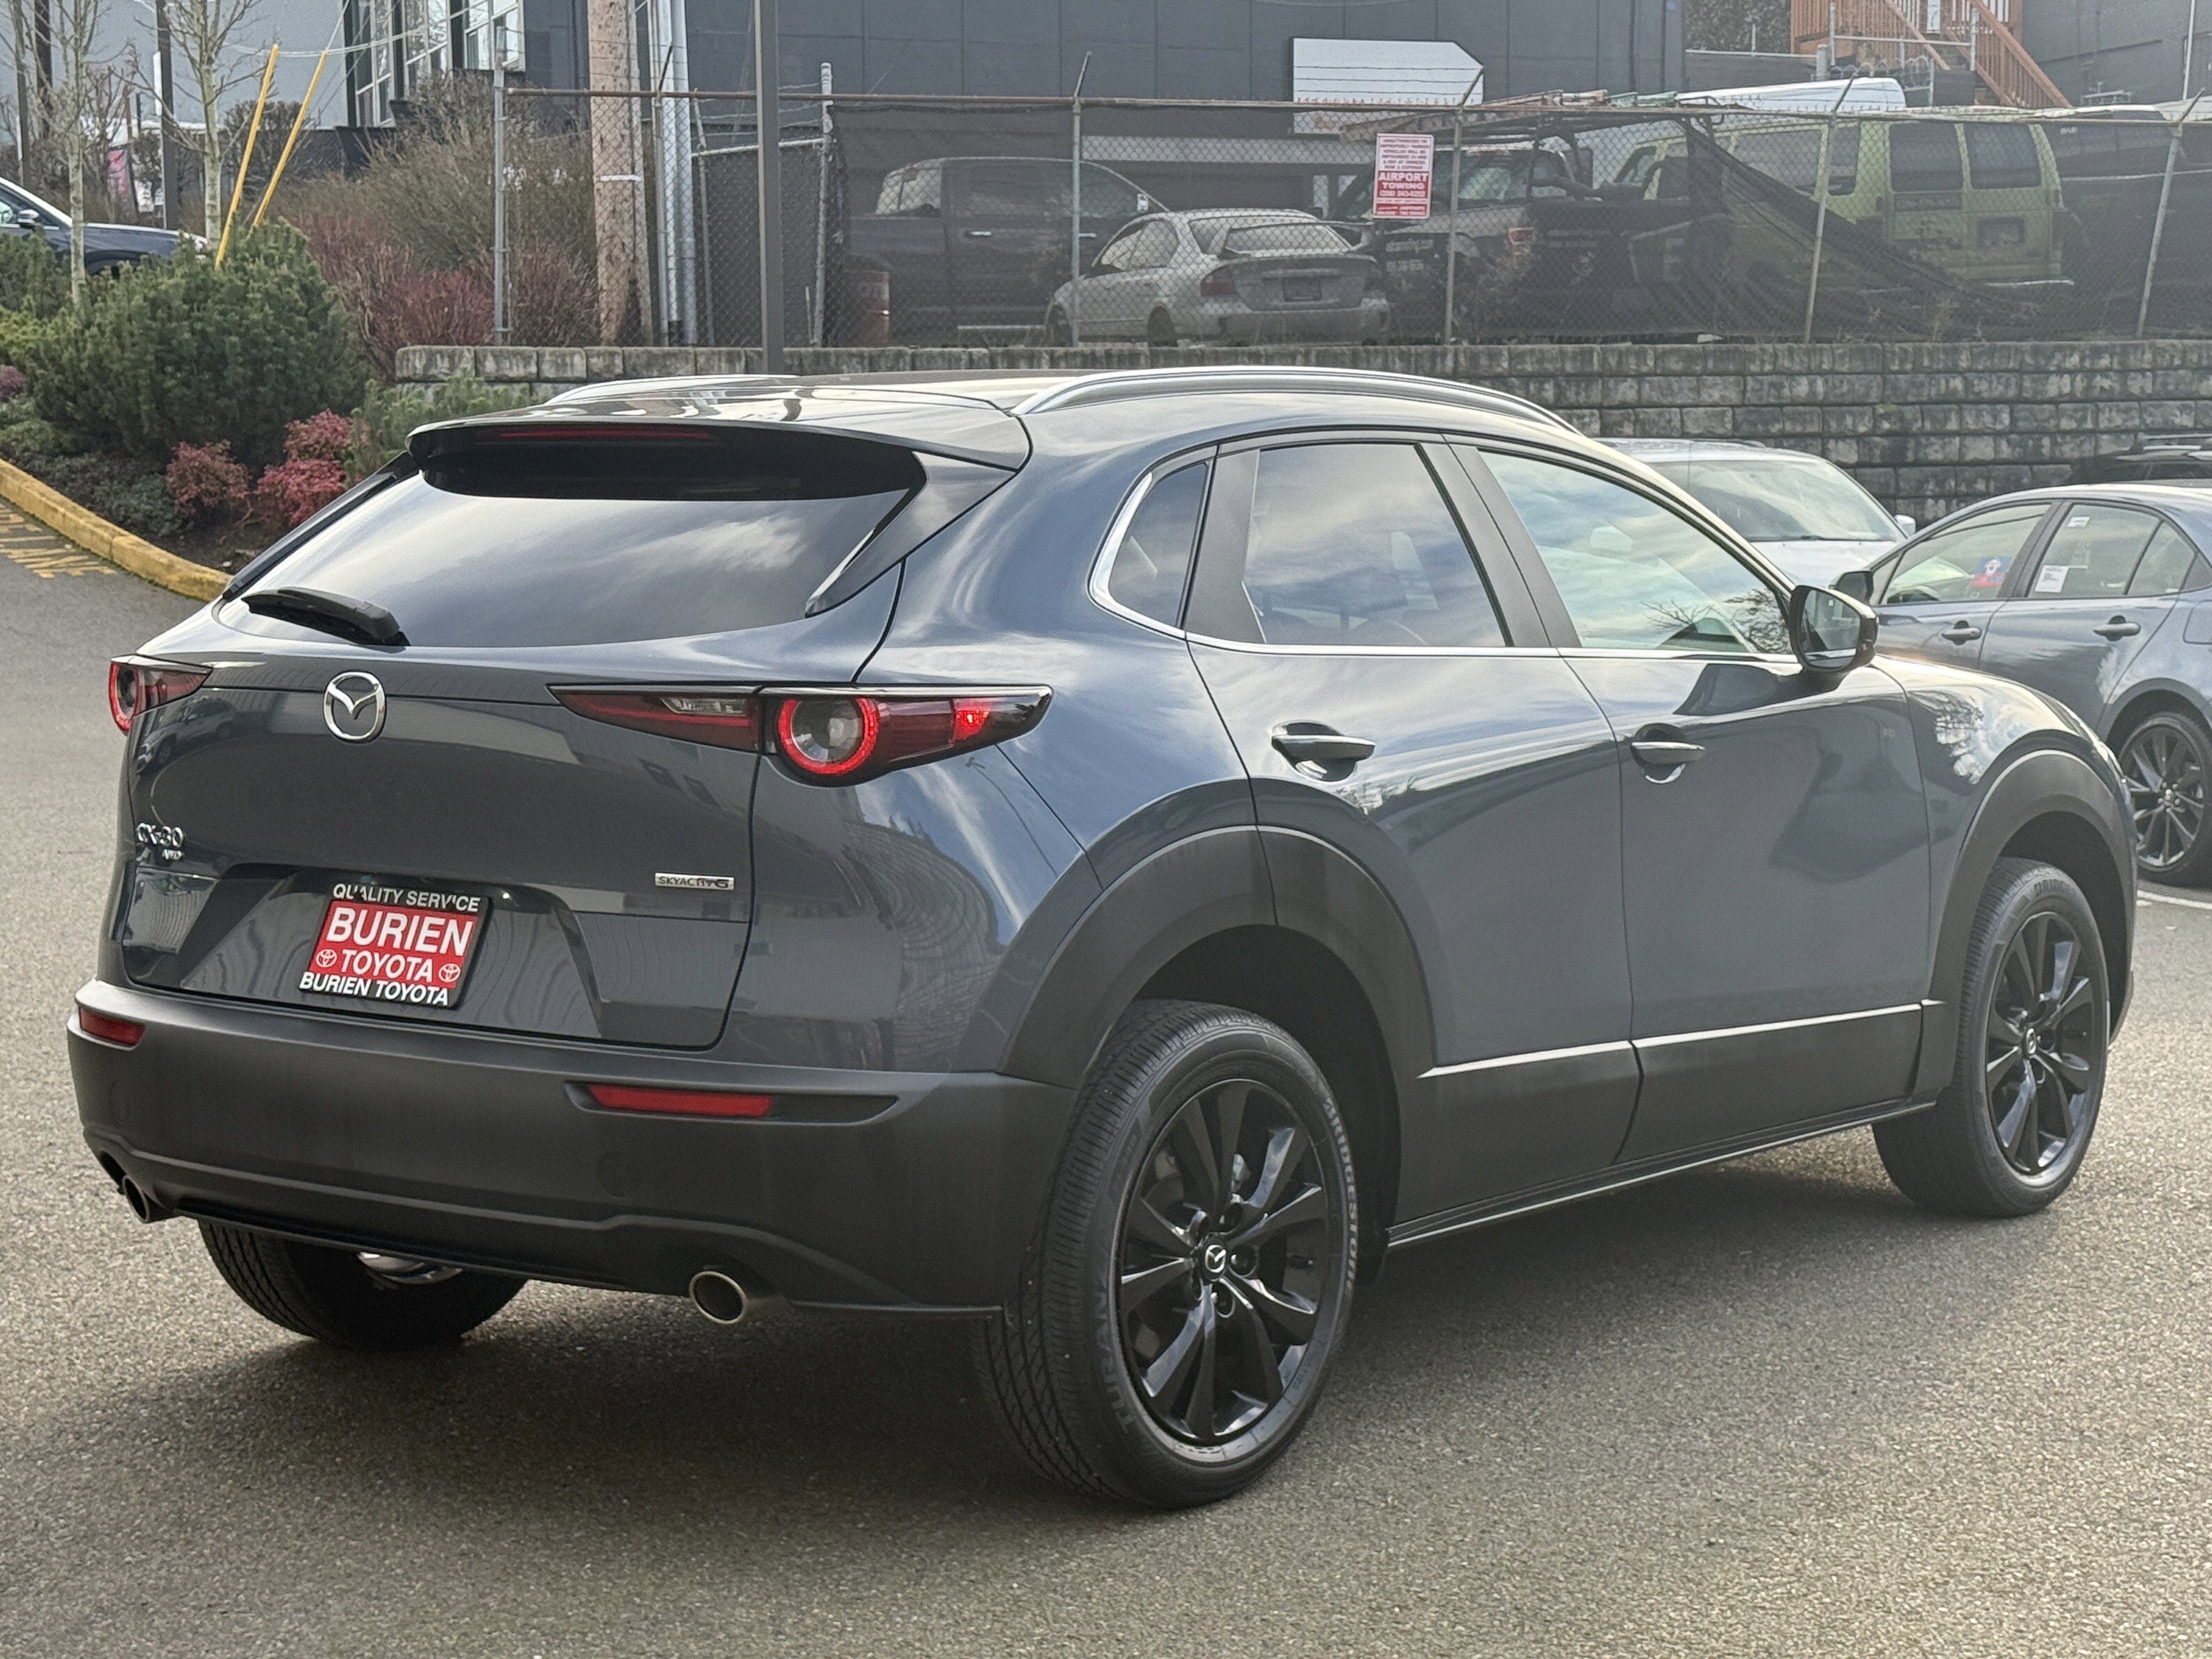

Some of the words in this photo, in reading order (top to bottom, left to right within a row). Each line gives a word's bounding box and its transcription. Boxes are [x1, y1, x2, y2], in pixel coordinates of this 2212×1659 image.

[1378, 172, 1429, 182] AIRPORT
[333, 883, 404, 904] QUALITY
[406, 890, 481, 912] SERVICE
[326, 906, 473, 956] BURIEN
[341, 949, 433, 983] TOYOTA
[300, 971, 372, 996] BURIEN
[375, 980, 449, 1007] TOYOTA
